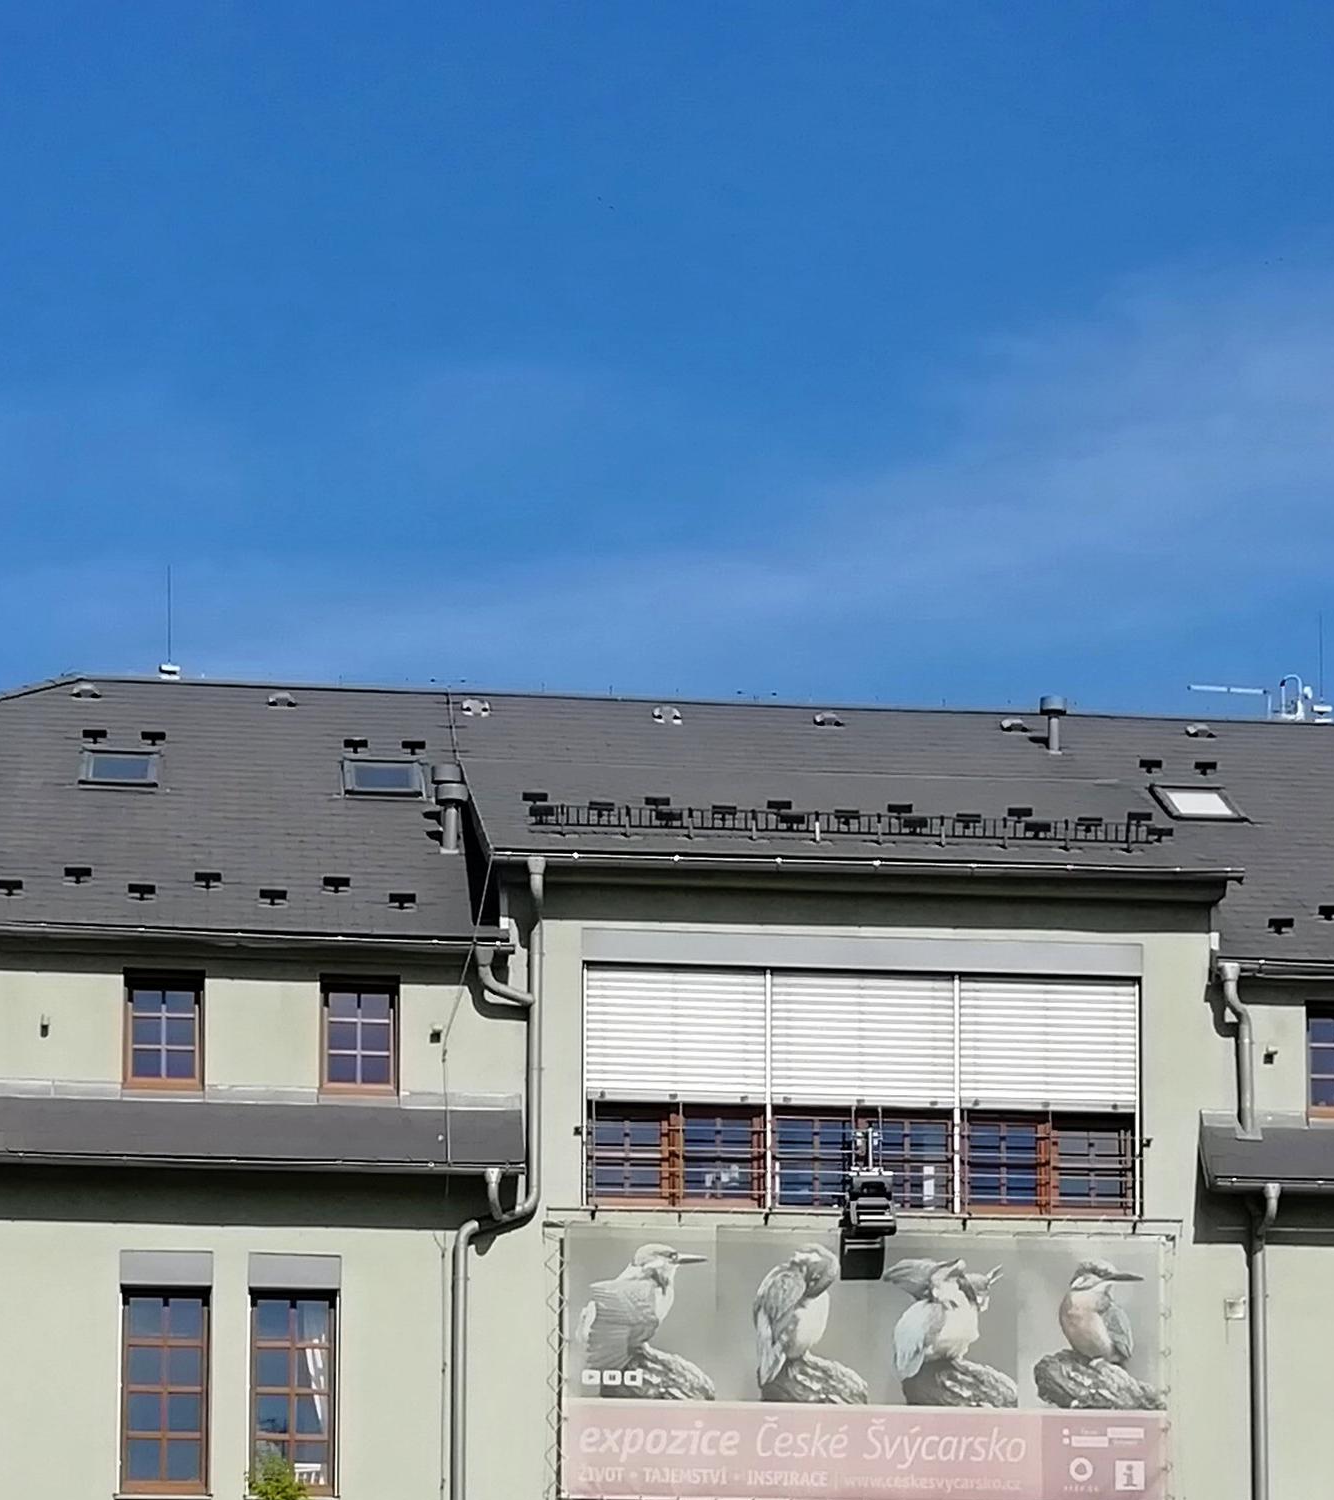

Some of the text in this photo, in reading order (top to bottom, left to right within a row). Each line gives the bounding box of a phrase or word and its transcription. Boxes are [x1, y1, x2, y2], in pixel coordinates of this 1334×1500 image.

[579, 1416, 1027, 1469] expozice České Švýcarsko
[577, 1464, 1022, 1493] ŽIVOT TAJEMSTVÍ INSPIRACE www.ceskesvycarsko.cz
